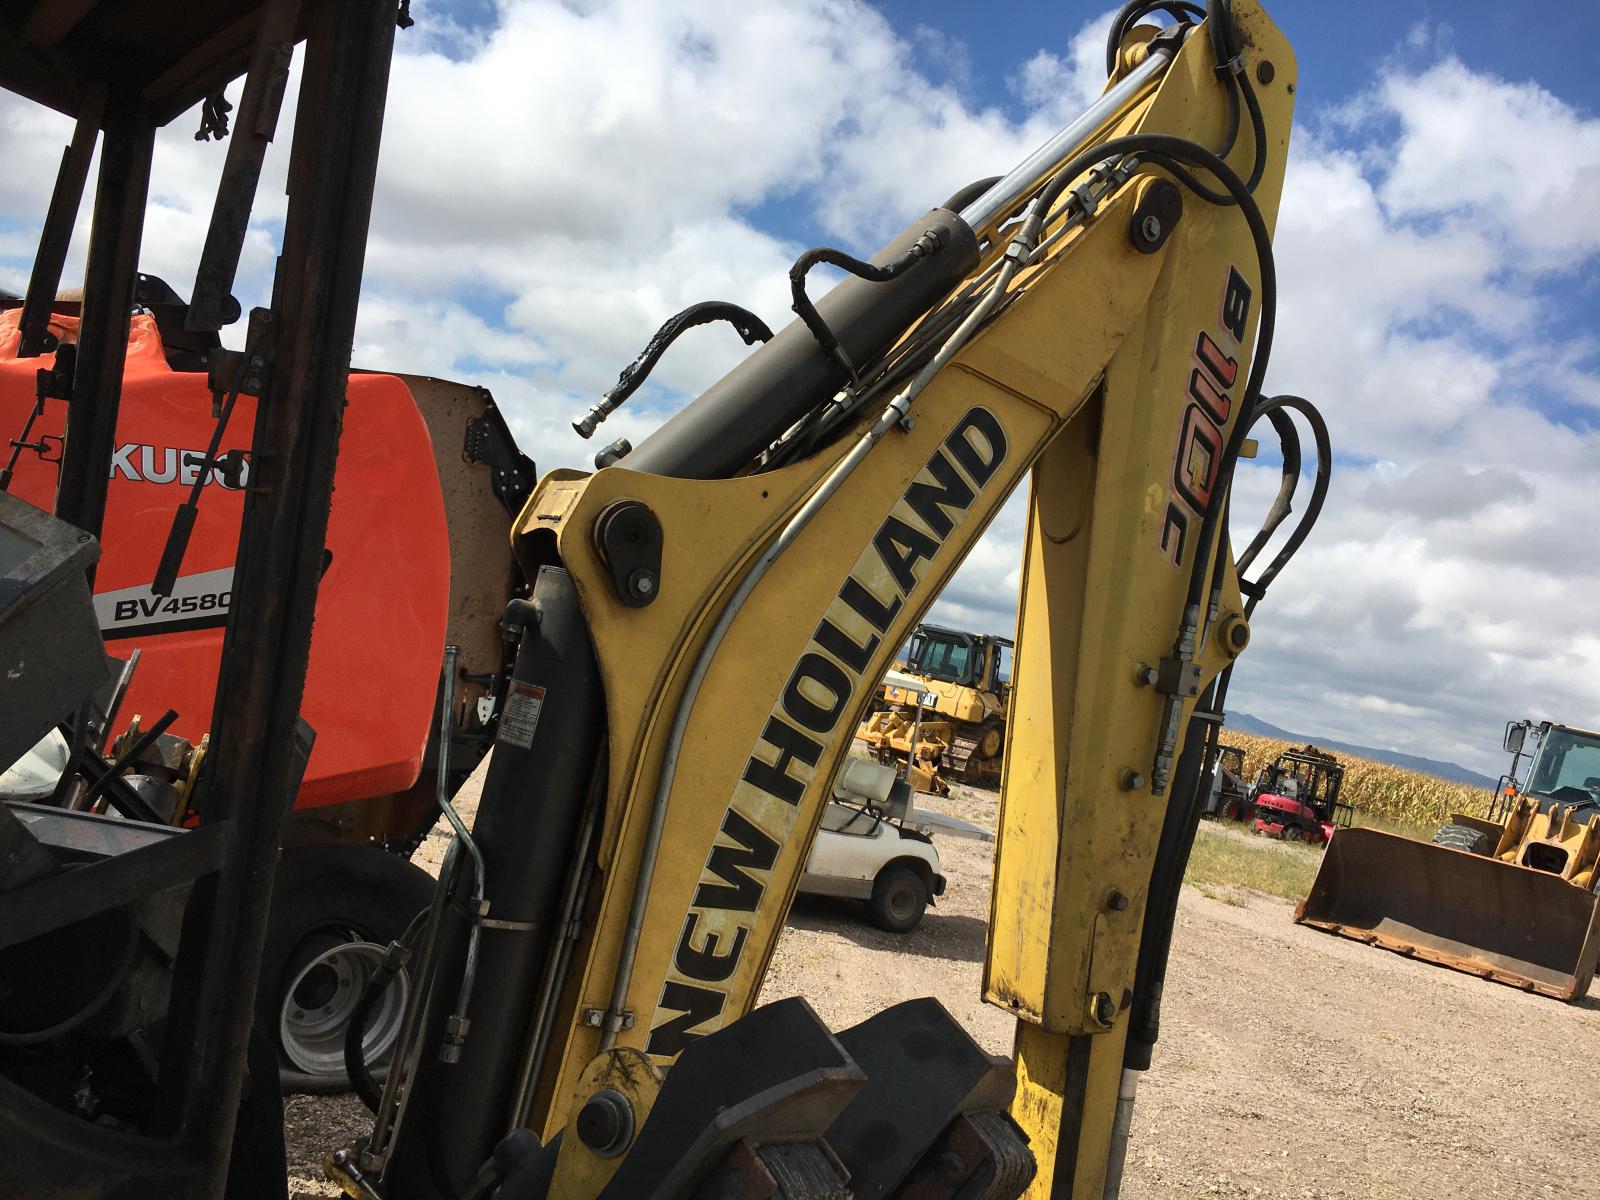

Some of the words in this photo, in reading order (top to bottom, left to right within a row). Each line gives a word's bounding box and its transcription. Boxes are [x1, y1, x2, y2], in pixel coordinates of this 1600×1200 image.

[114, 592, 231, 621] BV4580
[644, 808, 781, 1056] NEW
[743, 407, 1007, 806] HOLLAND
